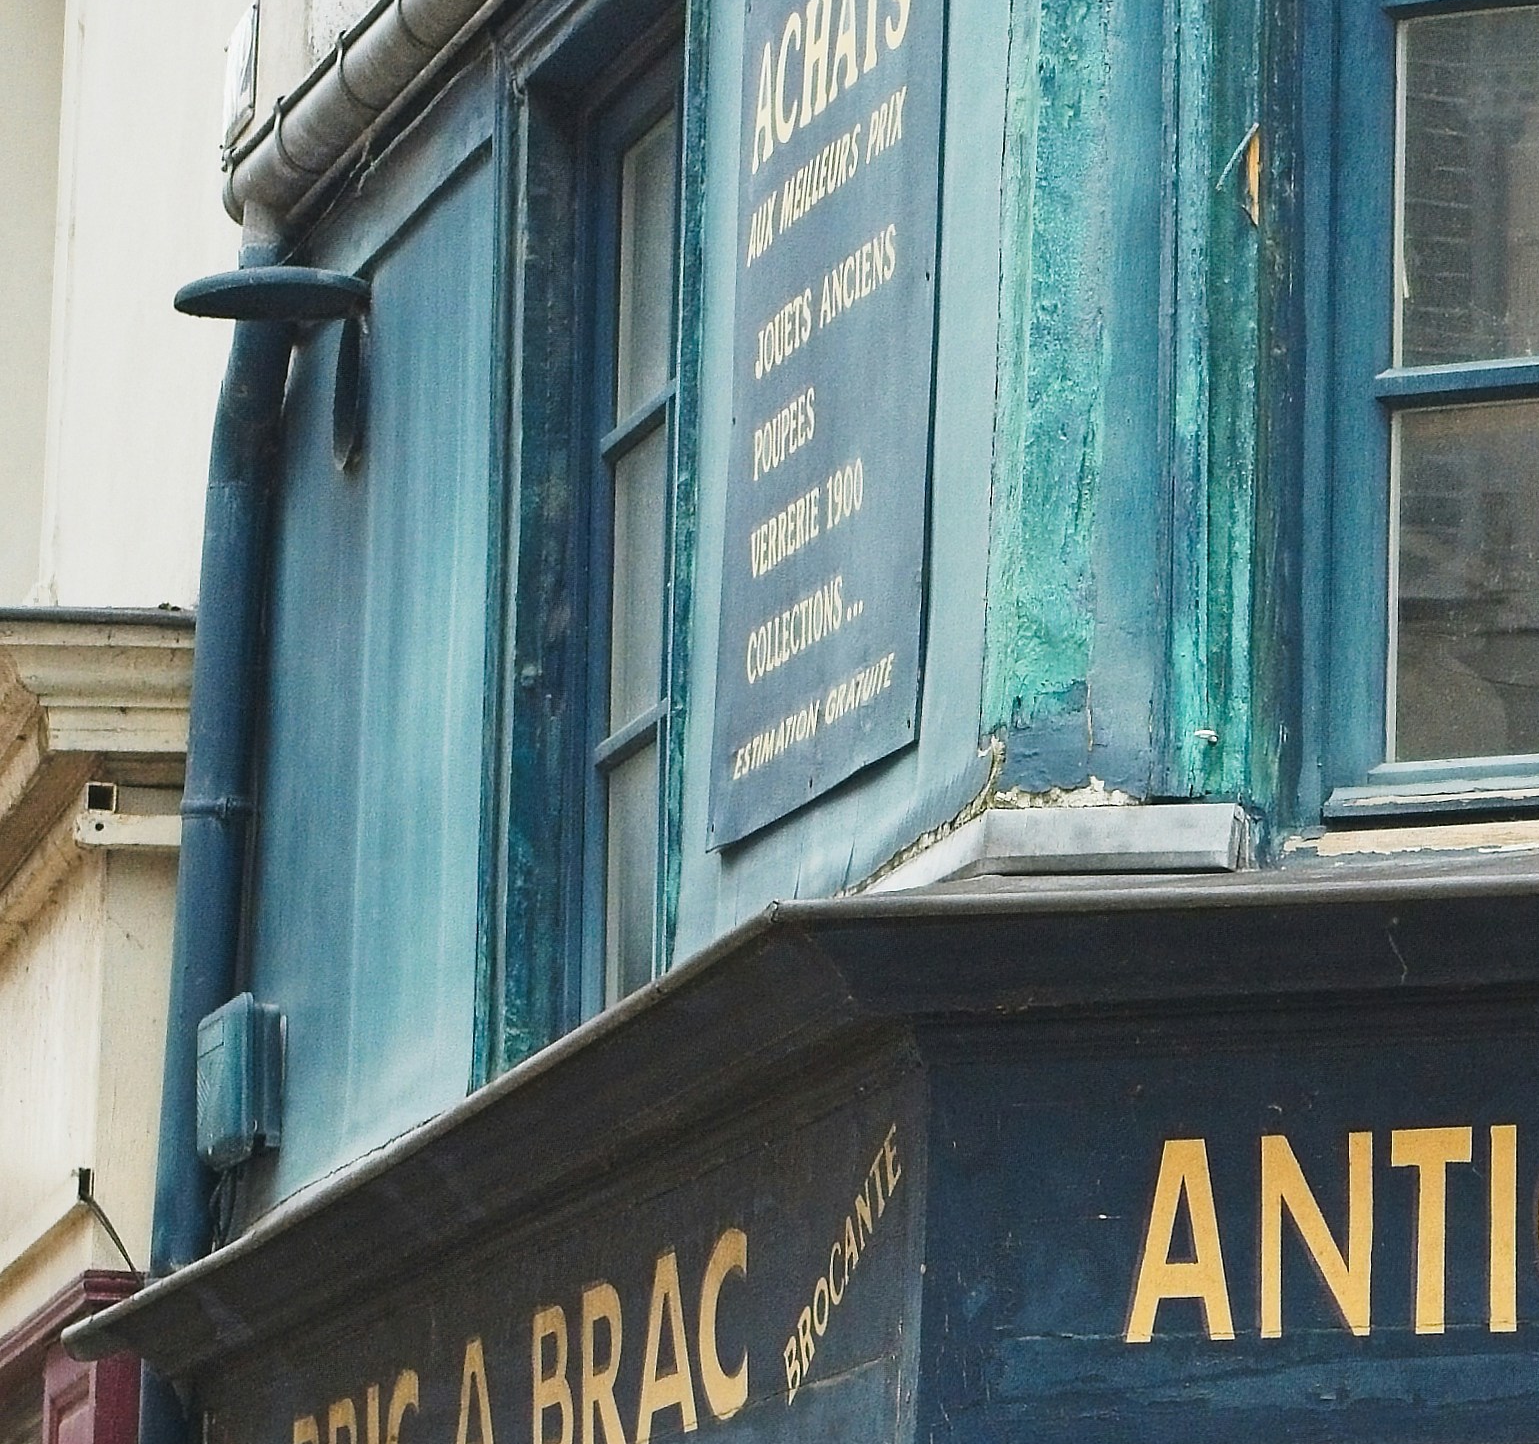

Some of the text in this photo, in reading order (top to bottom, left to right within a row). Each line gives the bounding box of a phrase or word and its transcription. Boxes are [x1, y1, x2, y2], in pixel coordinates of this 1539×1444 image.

[746, 85, 907, 268] AUX MEILLEURS PRIX
[755, 223, 897, 380] JOUETS ANCIENS
[753, 387, 815, 482] POUPEES
[750, 457, 864, 579] VERRERIE 1900
[733, 652, 895, 780] ESTIMATION GRATUITE
[783, 1123, 902, 1405] BROCANTE
